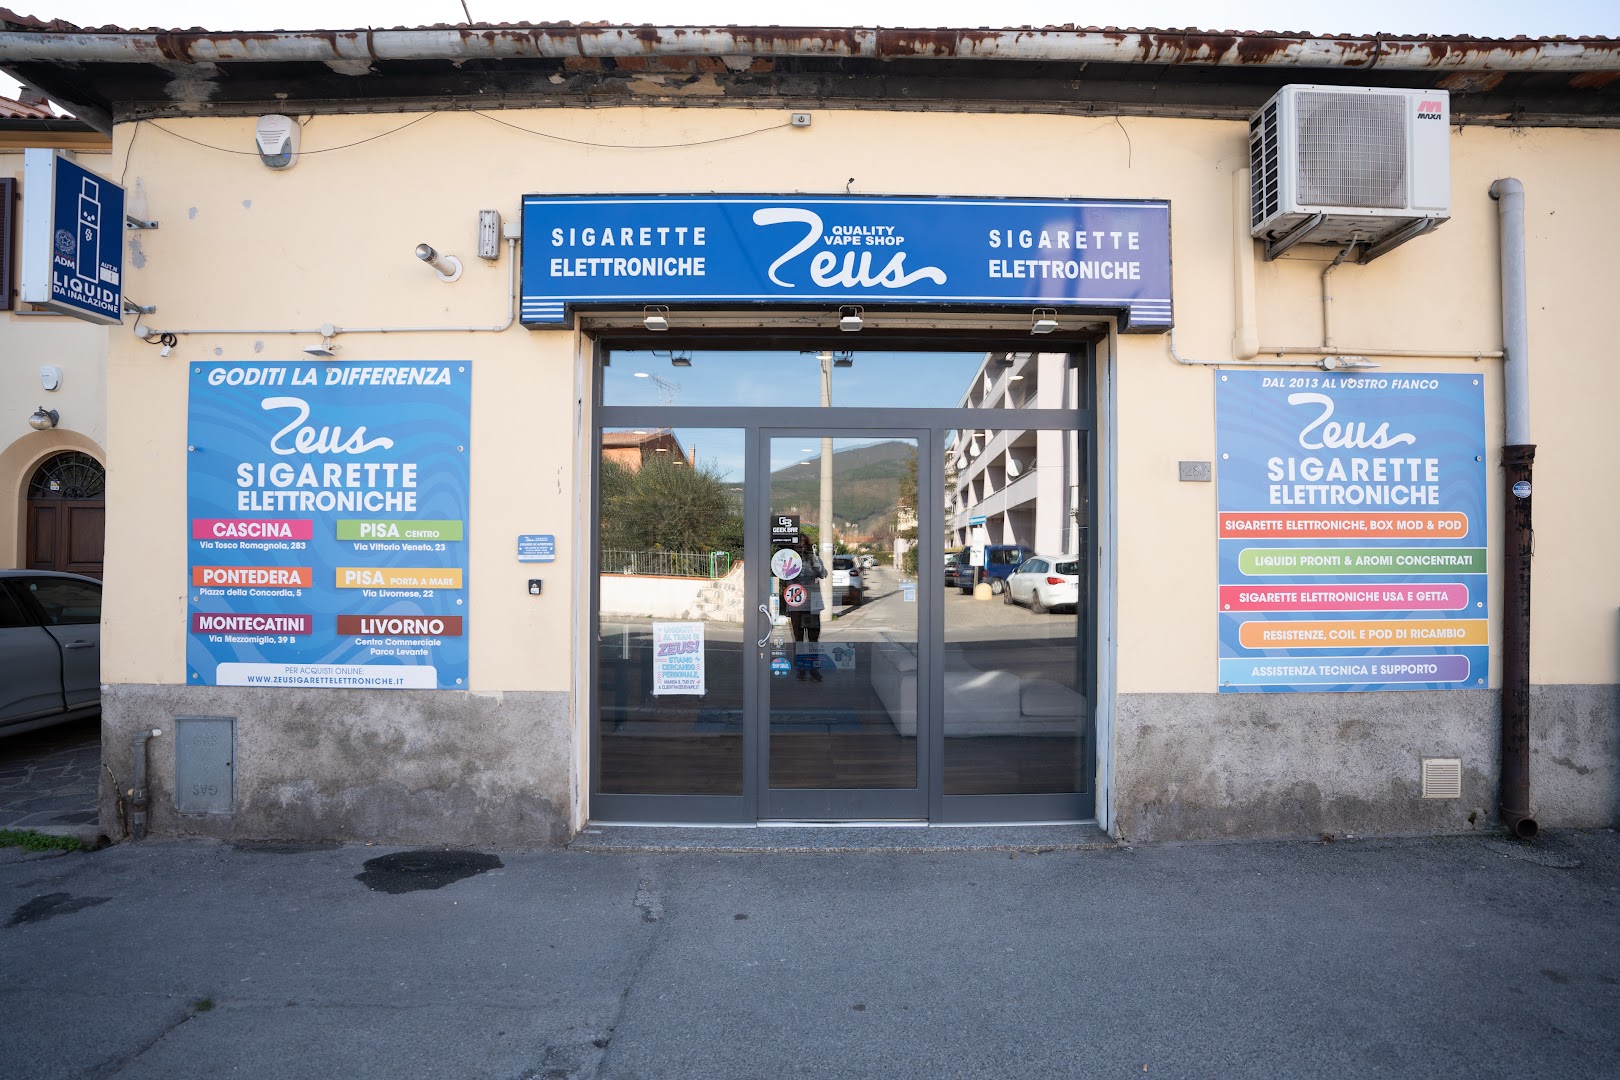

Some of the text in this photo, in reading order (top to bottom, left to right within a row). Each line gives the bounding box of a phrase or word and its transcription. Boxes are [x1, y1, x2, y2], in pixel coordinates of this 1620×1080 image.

[551, 227, 706, 247] SIGARETTE
[831, 225, 895, 236] QUALITY
[823, 236, 905, 246] VAPE SHOP
[989, 229, 1140, 250] SIGARETTE
[752, 207, 948, 289] Zeus
[54, 255, 75, 269] ADM
[550, 257, 706, 277] ELETTRONICHE
[988, 259, 1141, 280] ELETTRONICHE
[54, 271, 119, 306] LIQUIDI
[53, 285, 119, 313] DA INALAZIONE
[208, 367, 451, 386] GODITI LA DIFFERENZA
[1262, 377, 1439, 390] DAL 2013 AL VOSTRO FIANCO
[261, 396, 394, 455] Zeus
[1287, 392, 1416, 450] Zeus
[236, 462, 417, 488] SIGARETTE
[1267, 456, 1439, 482] SIGARETTE
[238, 490, 417, 512] ELETTRONICHE
[1269, 484, 1440, 505] ELETTRONICHE
[212, 522, 293, 537] CASCINA
[360, 523, 440, 538] PISA CENTRO
[1225, 520, 1462, 531] SIGARETTE ELETTRONICHE, BOX MOD & POD
[240, 542, 290, 551] Romagnola,
[353, 543, 446, 552] Via Vittorio Veneto, 23
[1255, 555, 1473, 567] LIQUIDI PRONTI & AROMI CONCENTRATI
[203, 569, 302, 584] PONTEDERA
[345, 570, 385, 585] PISA
[199, 588, 302, 597] Piazza della Concordia, 5
[362, 589, 377, 597] Via
[379, 589, 422, 598] Livornese,
[787, 588, 802, 603] -18
[1239, 591, 1449, 603] SIGARETTE ELETTRONICHE USA E GETTA
[199, 616, 305, 631] MONTECATINI
[360, 618, 445, 634] LIVORNO
[209, 635, 296, 645] Via Mezzomiglio, 39 B
[355, 638, 442, 646] Centro Commerciale
[1263, 628, 1466, 641] RESISTENZE, COIL E POD DI RICAMBIO
[370, 648, 429, 656] Parco Levante
[657, 640, 700, 657] ZEUS!
[300, 667, 333, 675] ACQUISTI
[335, 667, 365, 675] ONLINE:
[1251, 664, 1438, 677] ASSISTENZA TECNICA E SUPPORTO
[247, 675, 404, 685] WWW.ZEUSIGARETTELETTRONICHE.IT
